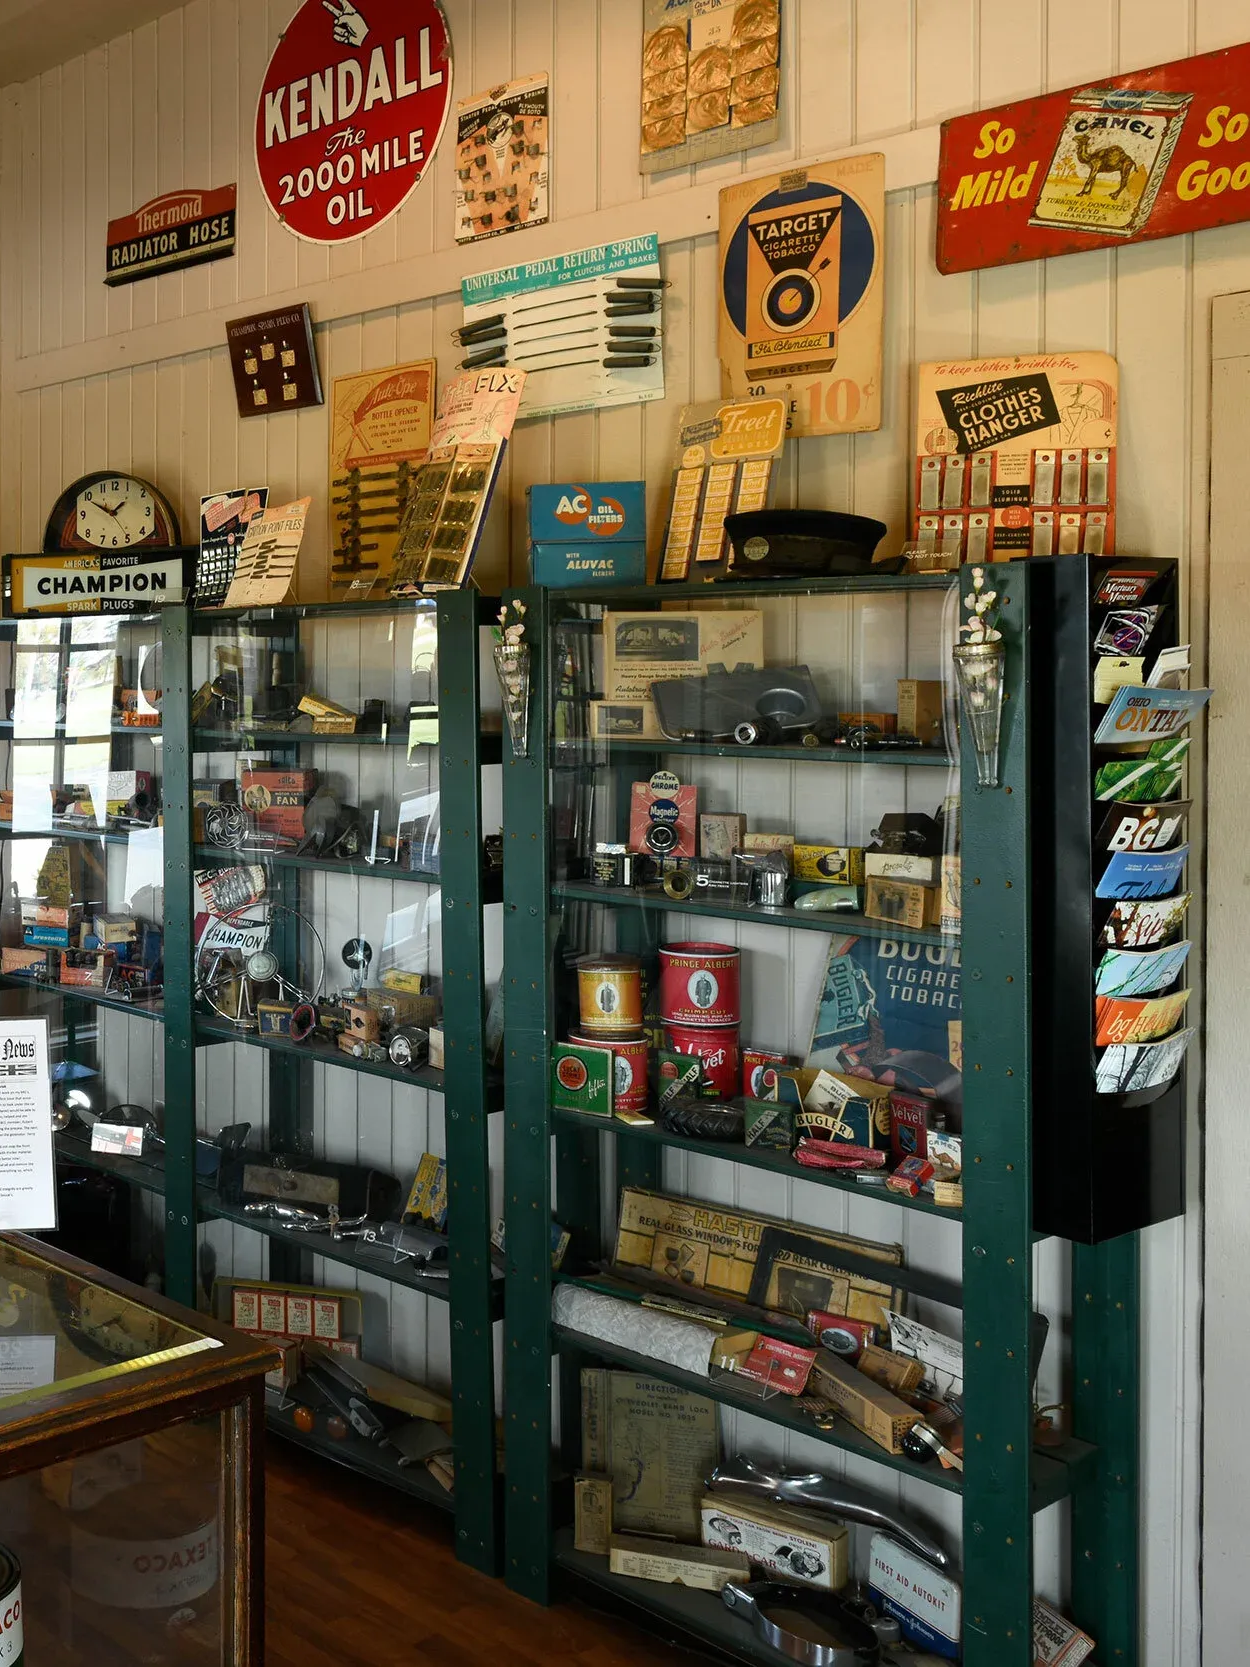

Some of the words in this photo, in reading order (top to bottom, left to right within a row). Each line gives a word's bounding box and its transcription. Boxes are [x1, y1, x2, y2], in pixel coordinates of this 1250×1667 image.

[265, 27, 442, 148] KENDALL
[1074, 117, 1155, 140] CAMEL
[1198, 106, 1249, 147] So
[325, 126, 366, 156] The
[974, 121, 1015, 158] So
[278, 154, 354, 206] 2000
[361, 129, 424, 178] MILE
[837, 162, 874, 176] MADE
[951, 161, 1039, 211] Mild
[327, 189, 372, 225] OIL
[757, 212, 831, 242] TARGET
[111, 231, 178, 267] RADIATOR
[189, 216, 230, 245] HOSE
[763, 233, 821, 252] CIGARETTE
[768, 244, 816, 260] TOBACCO
[466, 270, 519, 291] UNIVERSAL
[525, 259, 558, 277] PEDAL
[563, 247, 605, 269] RETURN
[612, 237, 653, 258] SPRING
[558, 272, 571, 281] FOR
[574, 264, 605, 277] CLUTCHES
[609, 259, 625, 269] AND
[629, 253, 656, 265] BRAKES
[768, 364, 811, 376] TARGET
[474, 373, 520, 394] FIX
[952, 381, 1004, 407] Richlite
[959, 387, 1042, 428] CLOTHES
[723, 409, 777, 433] Treet
[964, 405, 1046, 445] HANGER
[84, 491, 92, 501] 10
[111, 481, 119, 491] 12
[140, 488, 146, 498] 2
[80, 510, 86, 520] 9
[145, 506, 150, 516] 3
[556, 495, 587, 514] AC
[597, 505, 614, 515] OIL
[588, 513, 623, 524] FILTERS
[63, 558, 100, 568] AMERICA'S
[102, 556, 139, 566] FAVORITE
[37, 572, 167, 595] CHAMPION
[67, 602, 97, 611] SPARK
[103, 600, 135, 610] PLUGS
[1126, 697, 1151, 706] OHIO
[651, 782, 679, 791] CHROME
[277, 797, 298, 805] FAN
[650, 805, 679, 818] Magnetic
[33, 935, 66, 943] prestolite
[207, 929, 263, 949] CHAMPION
[670, 958, 700, 968] PRINCE
[704, 960, 735, 968] ALBERT
[828, 961, 857, 1029] BUGLER
[2, 1038, 35, 1061] News
[796, 1114, 848, 1134] BUGLER
[892, 1103, 923, 1125] Velvet
[639, 1216, 662, 1231] REAL
[664, 1222, 693, 1237] GLASS
[695, 1229, 740, 1248] WINDOWS
[743, 1241, 759, 1252] FOR
[875, 1558, 893, 1576] FIRST
[896, 1573, 909, 1588] AID
[913, 1586, 945, 1612] AUTOKIT
